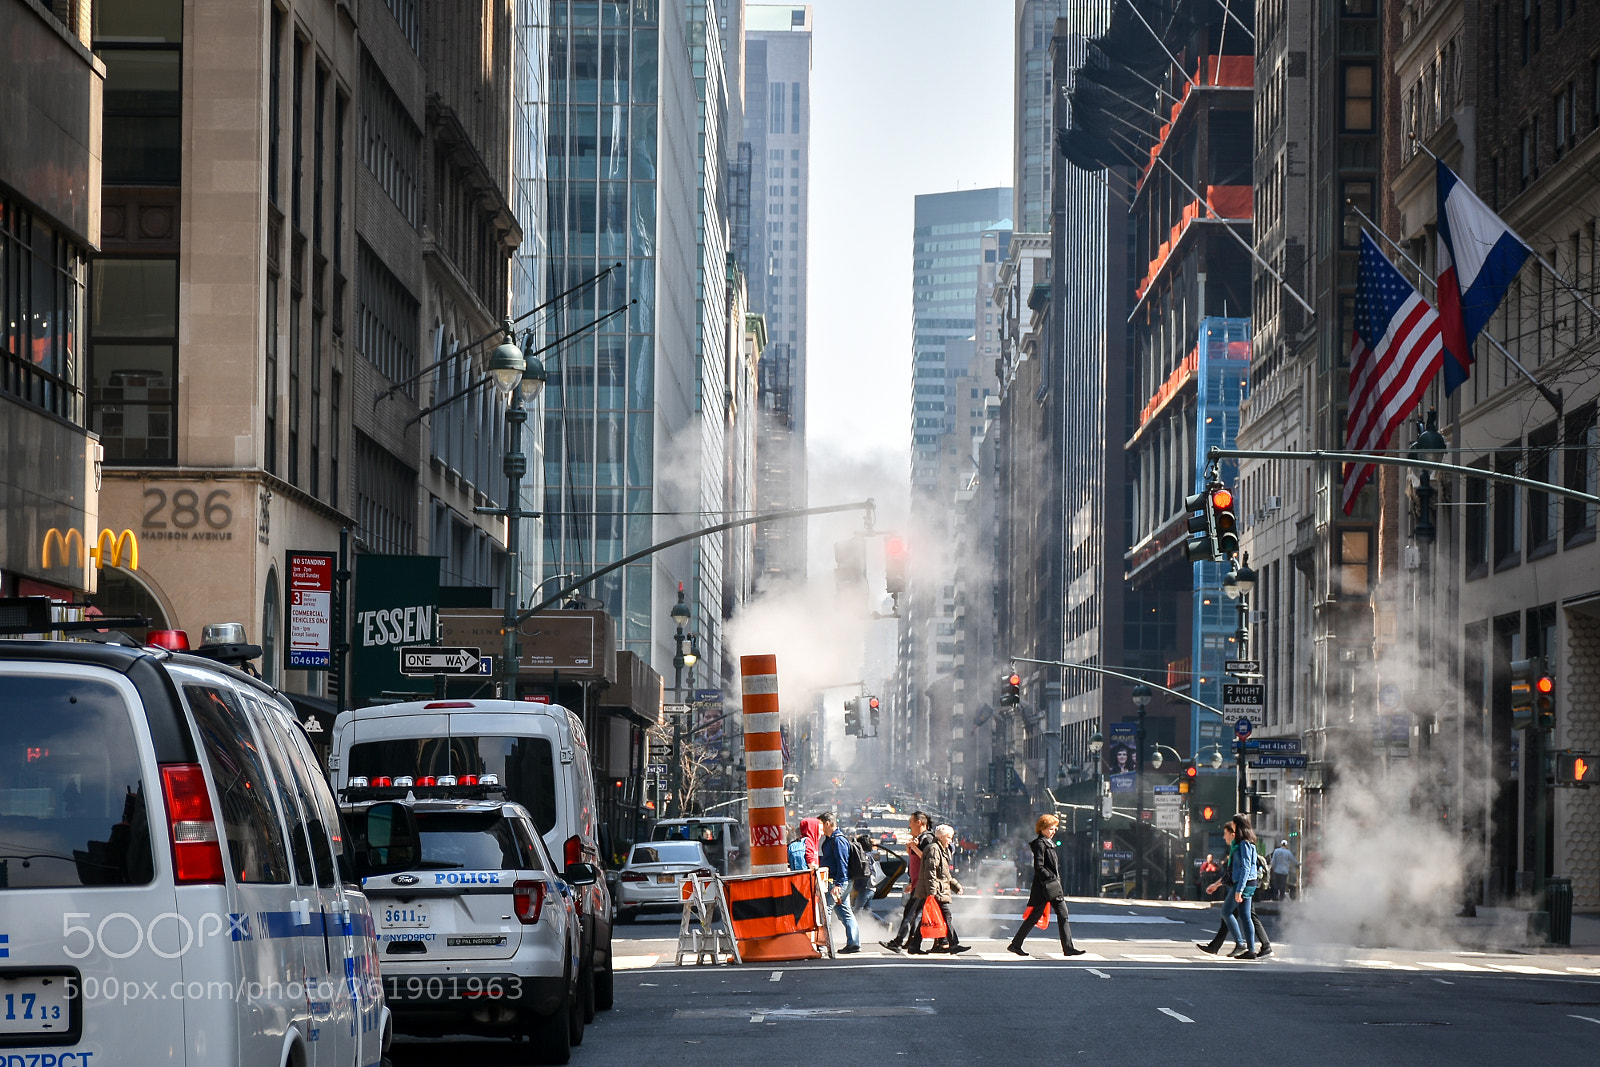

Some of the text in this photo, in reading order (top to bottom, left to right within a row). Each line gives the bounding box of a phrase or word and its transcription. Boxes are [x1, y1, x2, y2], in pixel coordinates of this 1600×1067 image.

[142, 488, 232, 529] 286
[142, 531, 232, 540] MADISON AVENUE
[301, 558, 326, 566] STANDING
[293, 592, 301, 605] 3
[292, 609, 324, 617] COMMERCIAL
[291, 616, 315, 624] VEHICLES
[290, 656, 320, 665] 104612
[408, 655, 471, 666] ONE WAY
[1227, 686, 1260, 695] 2 RIGHT
[1229, 696, 1258, 704] LANES
[1273, 742, 1287, 750] 41st
[1289, 742, 1296, 750] St
[1260, 757, 1304, 766] Library Way
[434, 873, 500, 884] POLICE
[385, 910, 415, 922] 3611
